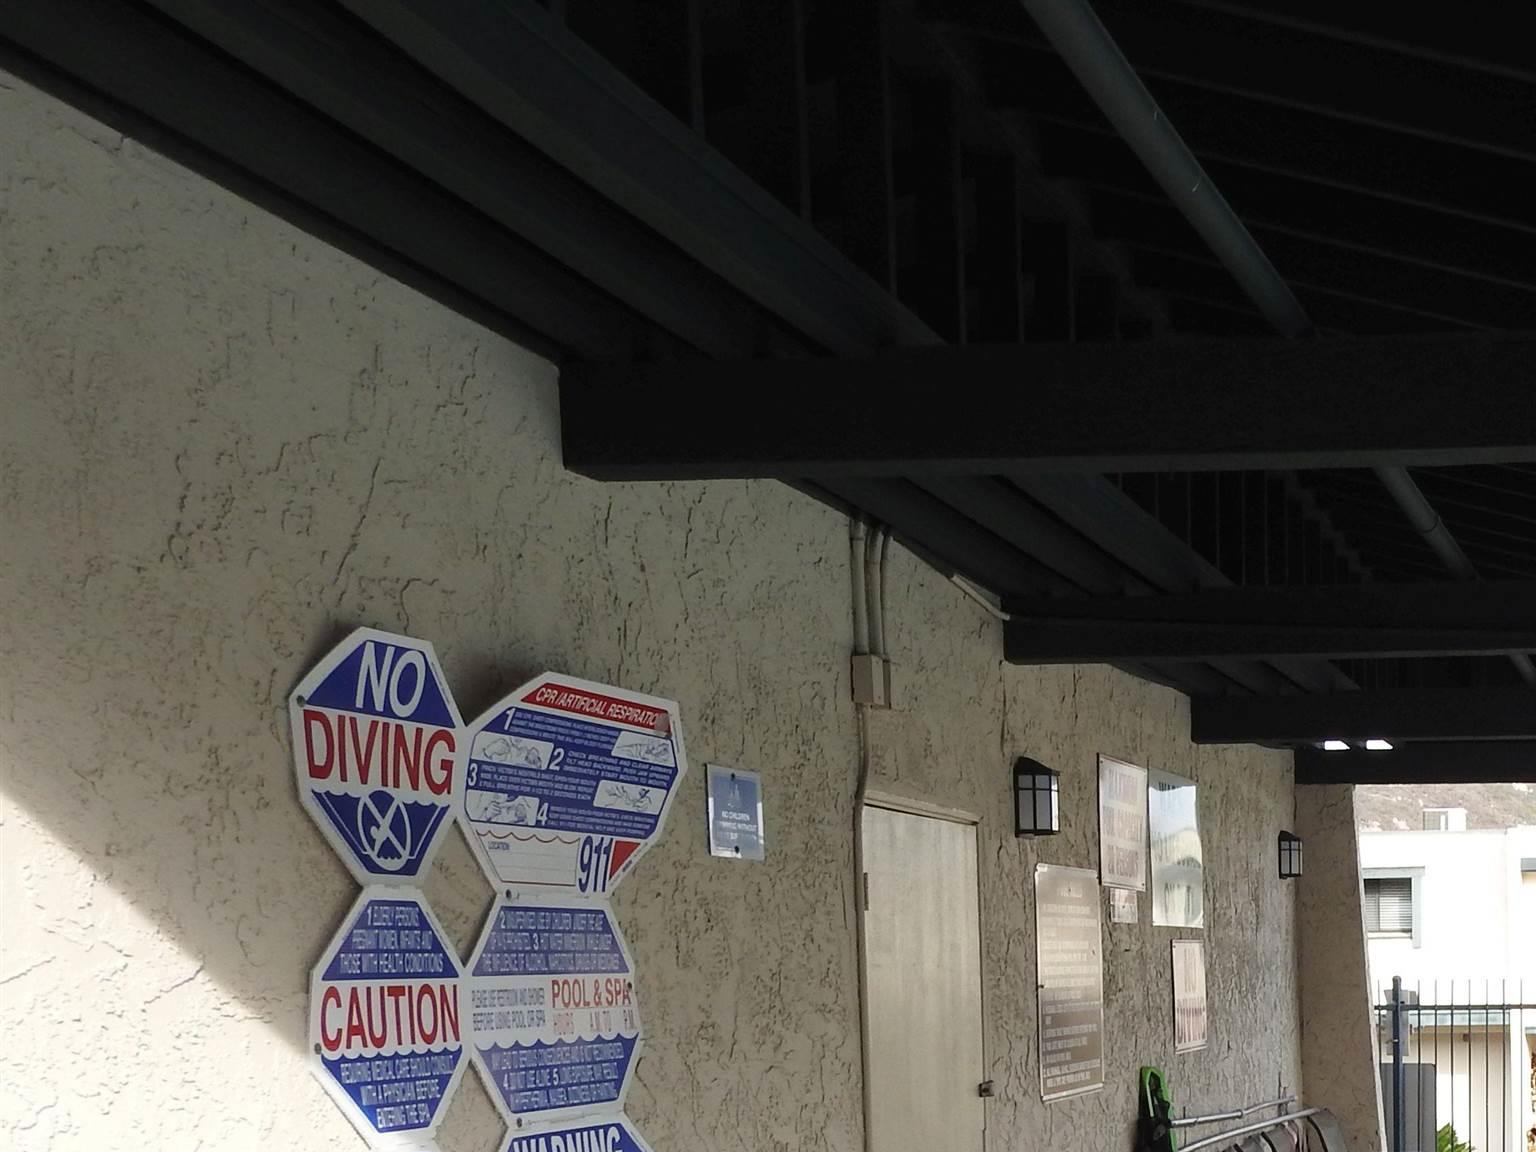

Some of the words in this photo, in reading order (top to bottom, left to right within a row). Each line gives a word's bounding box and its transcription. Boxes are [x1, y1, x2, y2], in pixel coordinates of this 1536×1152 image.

[355, 640, 426, 718] NO
[503, 708, 516, 731] 1
[606, 704, 661, 727] RESPIRATIO
[303, 708, 456, 796] DIVING
[549, 748, 565, 771] 2
[468, 763, 478, 786] 3
[537, 802, 549, 826] 4
[578, 835, 614, 893] 911
[367, 906, 373, 926] 1
[500, 910, 506, 929] 2
[533, 932, 540, 950] 3
[551, 979, 591, 1009] POOL
[593, 978, 602, 1007] &
[605, 977, 632, 1007] SPA
[321, 984, 461, 1052] CAUTION
[552, 1068, 559, 1086] 5
